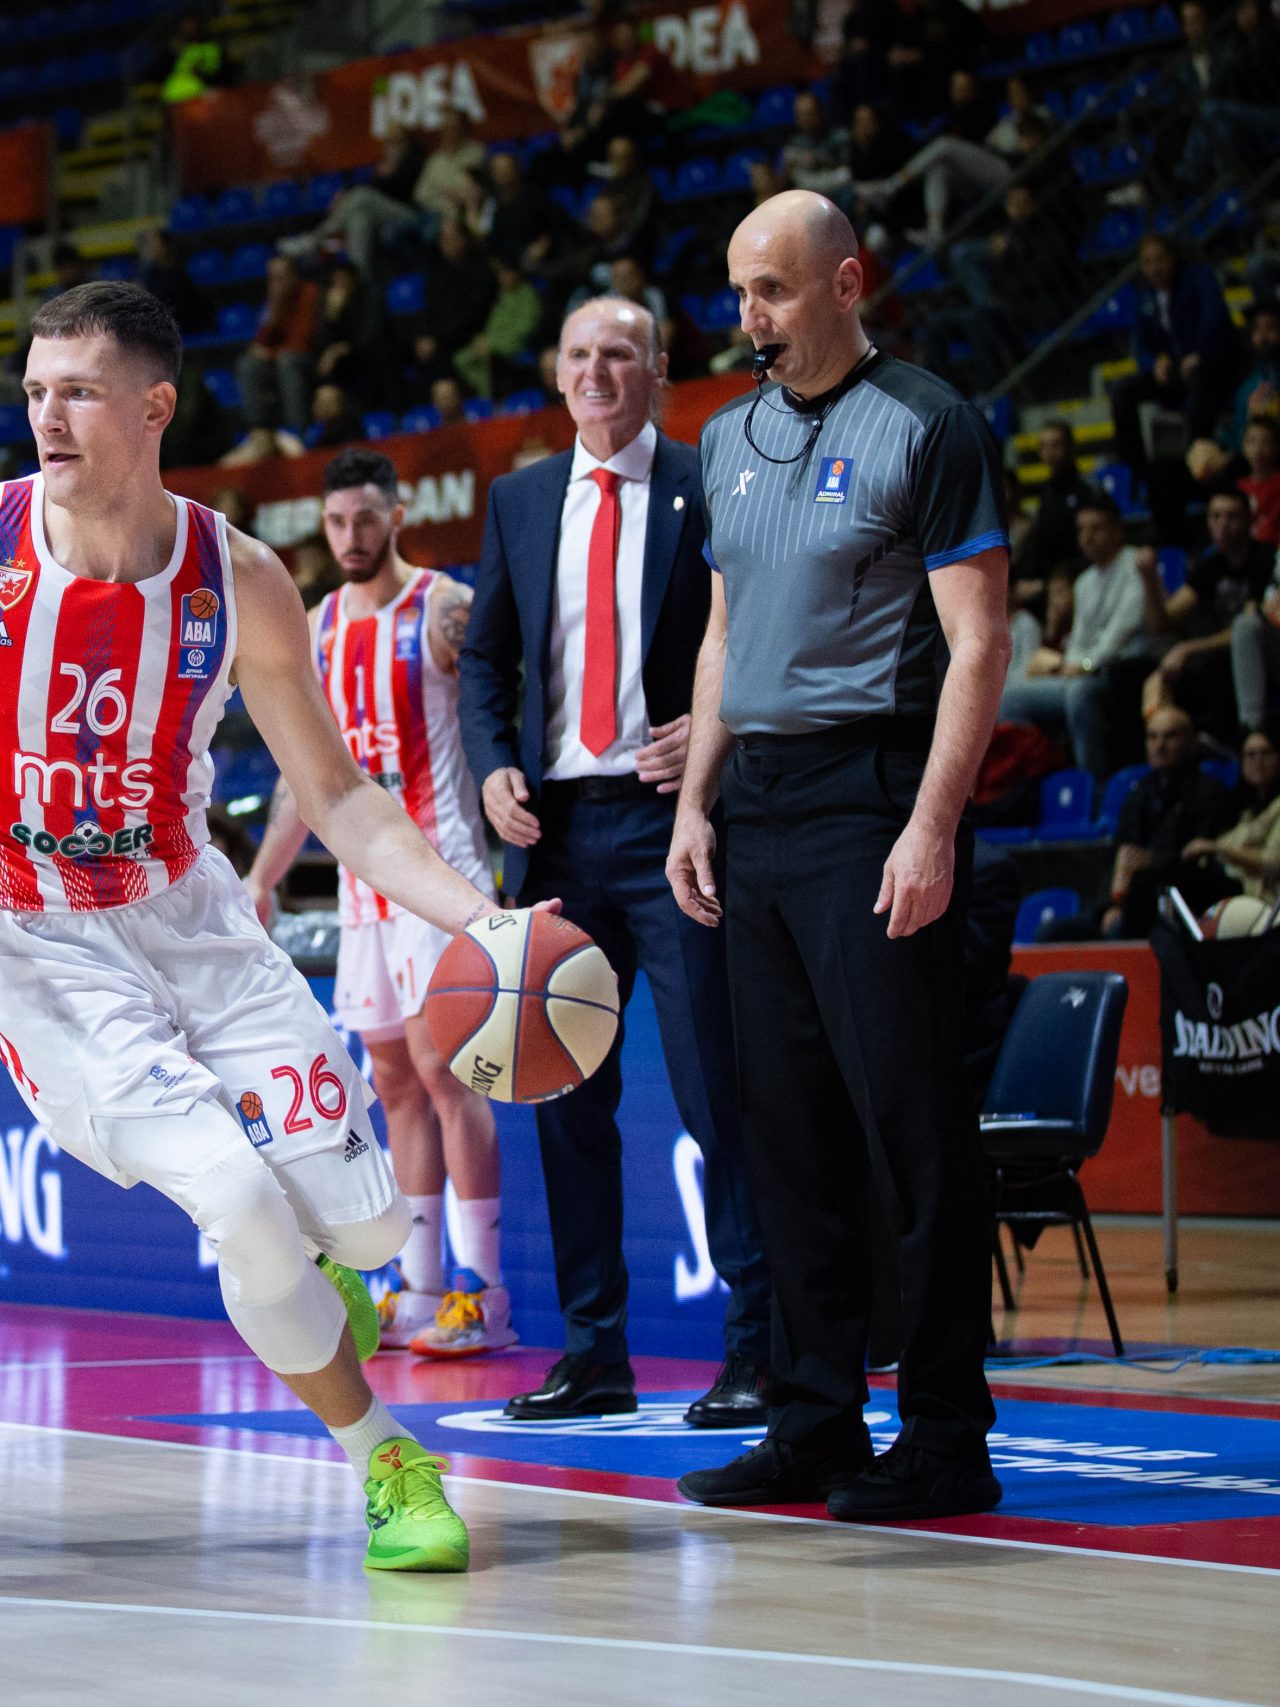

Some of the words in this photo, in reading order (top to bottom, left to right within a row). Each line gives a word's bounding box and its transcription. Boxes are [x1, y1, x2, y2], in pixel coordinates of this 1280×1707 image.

[183, 620, 212, 642] ABA
[51, 662, 128, 737] 26
[14, 752, 154, 808] mts
[270, 1053, 347, 1135] 26
[247, 1120, 271, 1145] ABA
[344, 1142, 371, 1163] adidas
